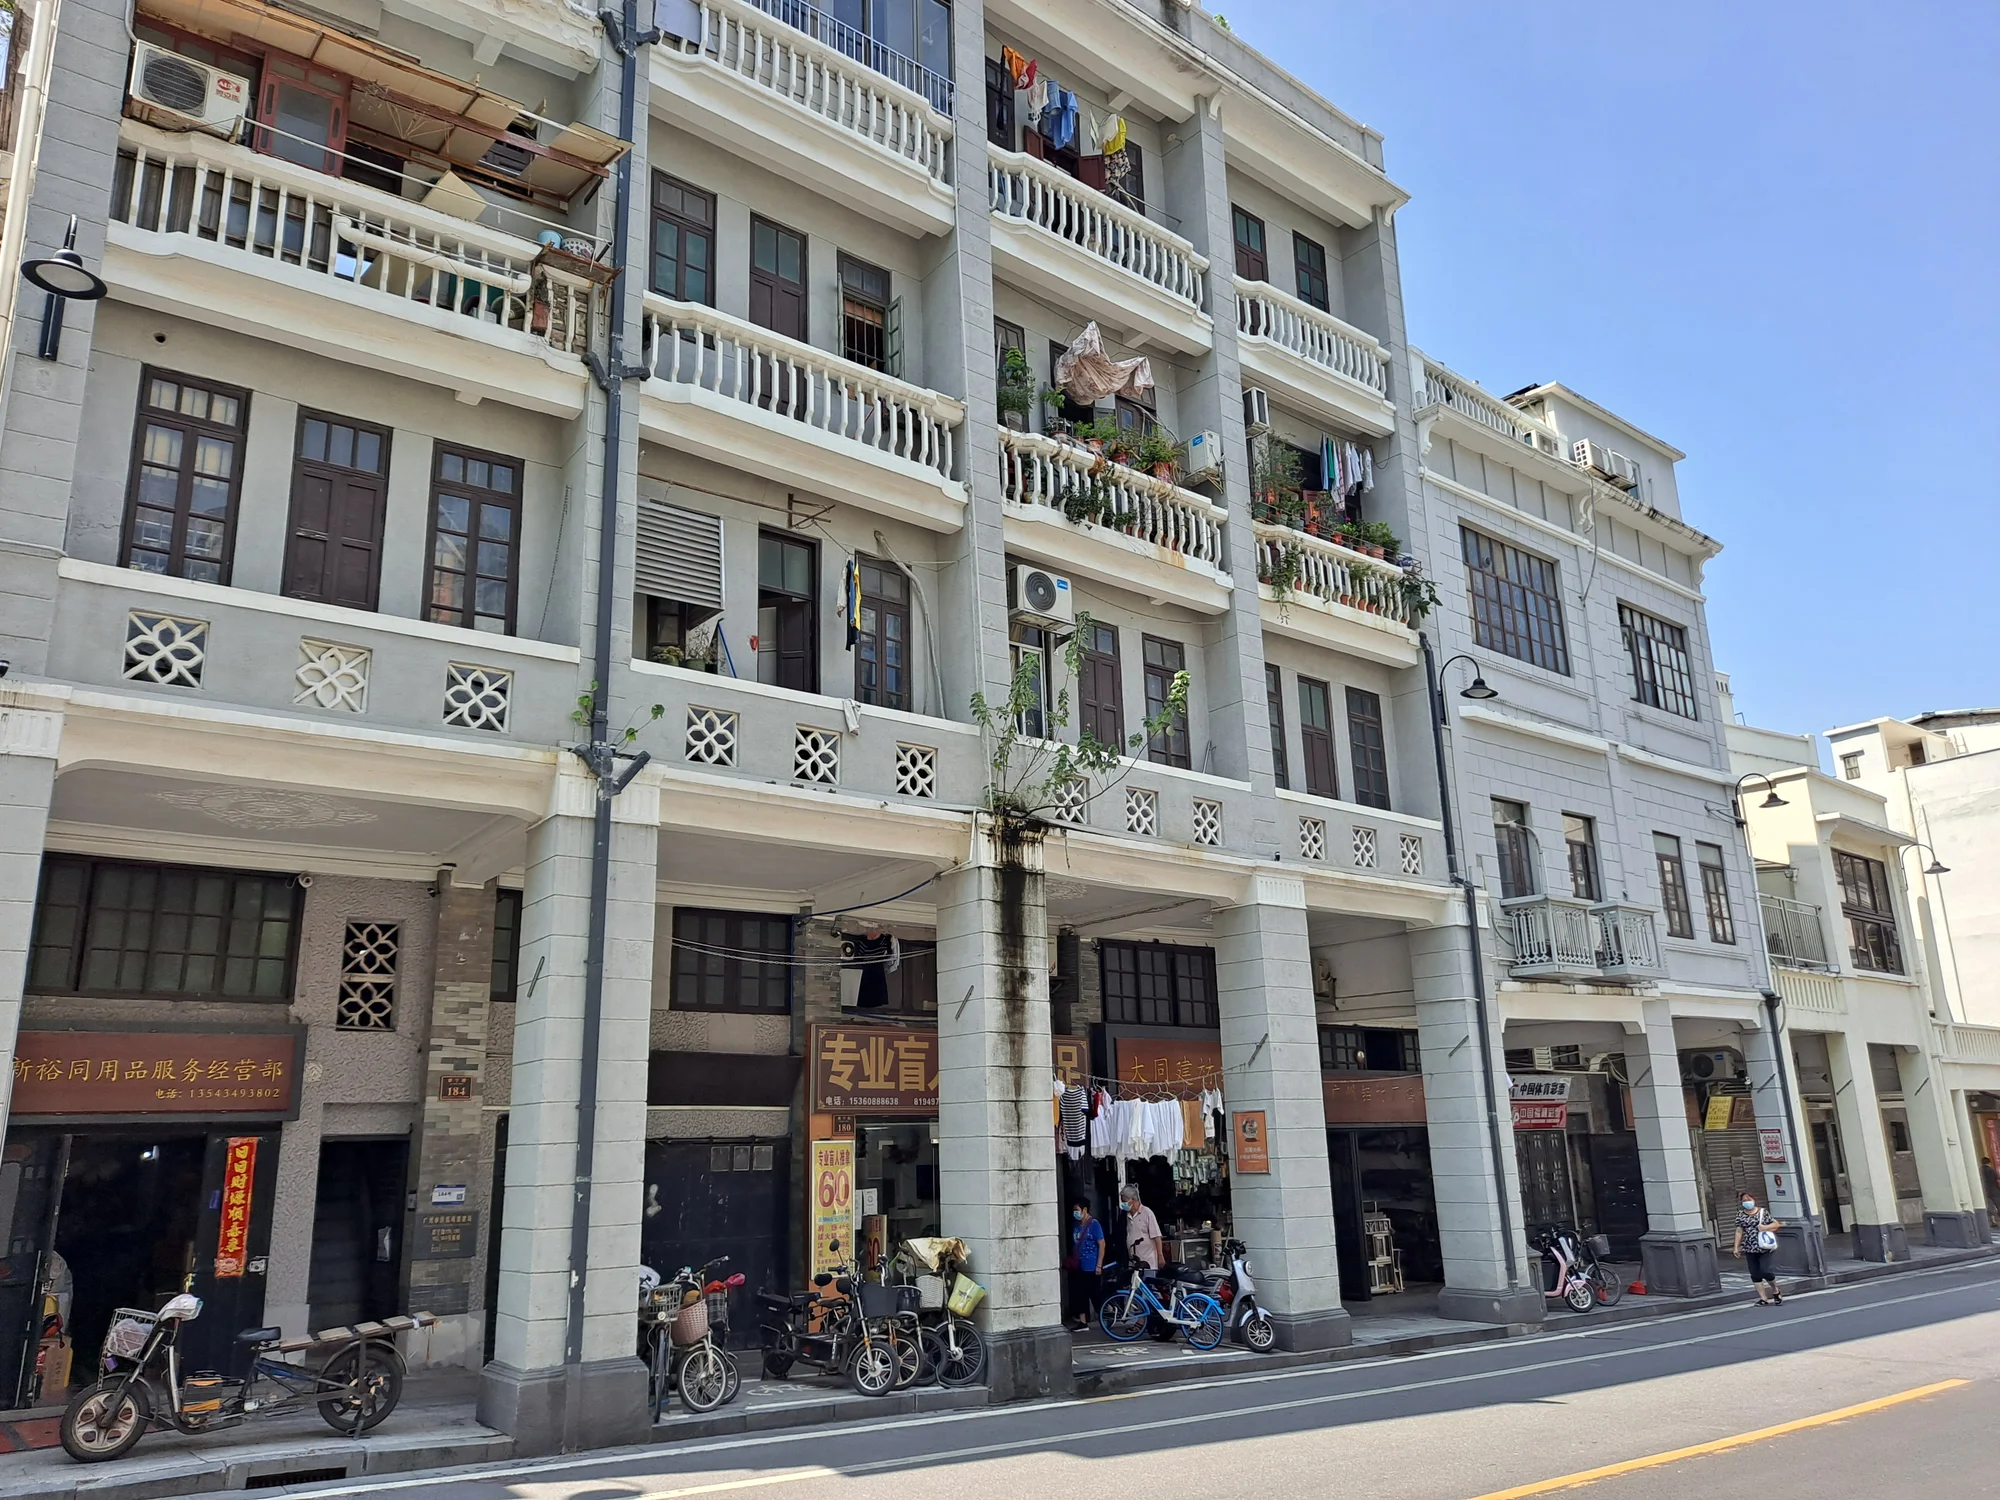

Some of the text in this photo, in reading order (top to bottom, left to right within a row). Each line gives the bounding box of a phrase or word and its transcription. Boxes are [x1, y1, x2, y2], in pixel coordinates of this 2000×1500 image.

[13, 1056, 283, 1083] 新裕同用品服务经营部
[1130, 1055, 1215, 1087] 大同建材
[189, 1089, 280, 1098] 13543493802
[448, 1087, 466, 1096] 184
[1520, 1082, 1566, 1096] 中国体育彩票
[838, 1124, 851, 1132] 180
[818, 1149, 850, 1167] 专业盲人推拿
[818, 1170, 850, 1208] 60
